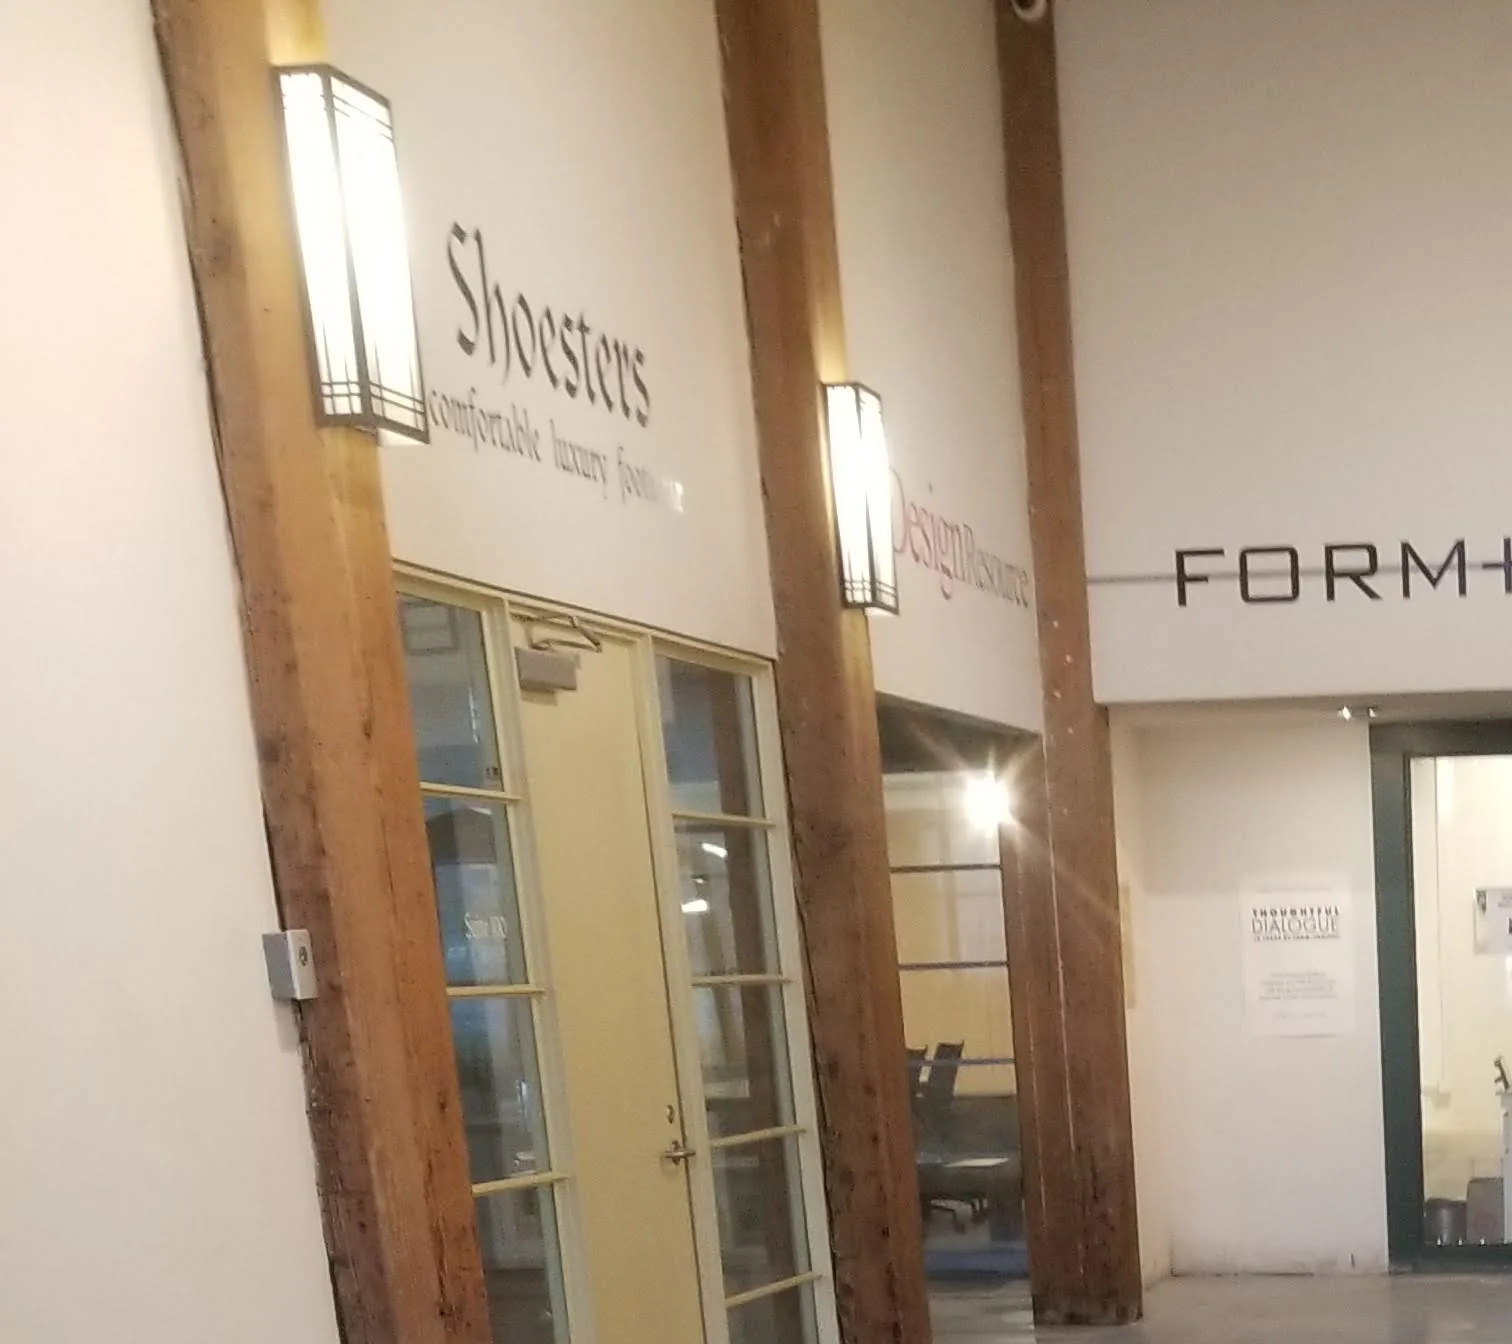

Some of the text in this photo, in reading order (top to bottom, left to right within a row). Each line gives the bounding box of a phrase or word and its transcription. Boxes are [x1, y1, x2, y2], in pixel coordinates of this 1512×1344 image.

[447, 221, 652, 429] Shoesters
[428, 386, 543, 464] comfortable
[549, 417, 609, 501] luxury
[1251, 917, 1339, 934] DIALOGUE
